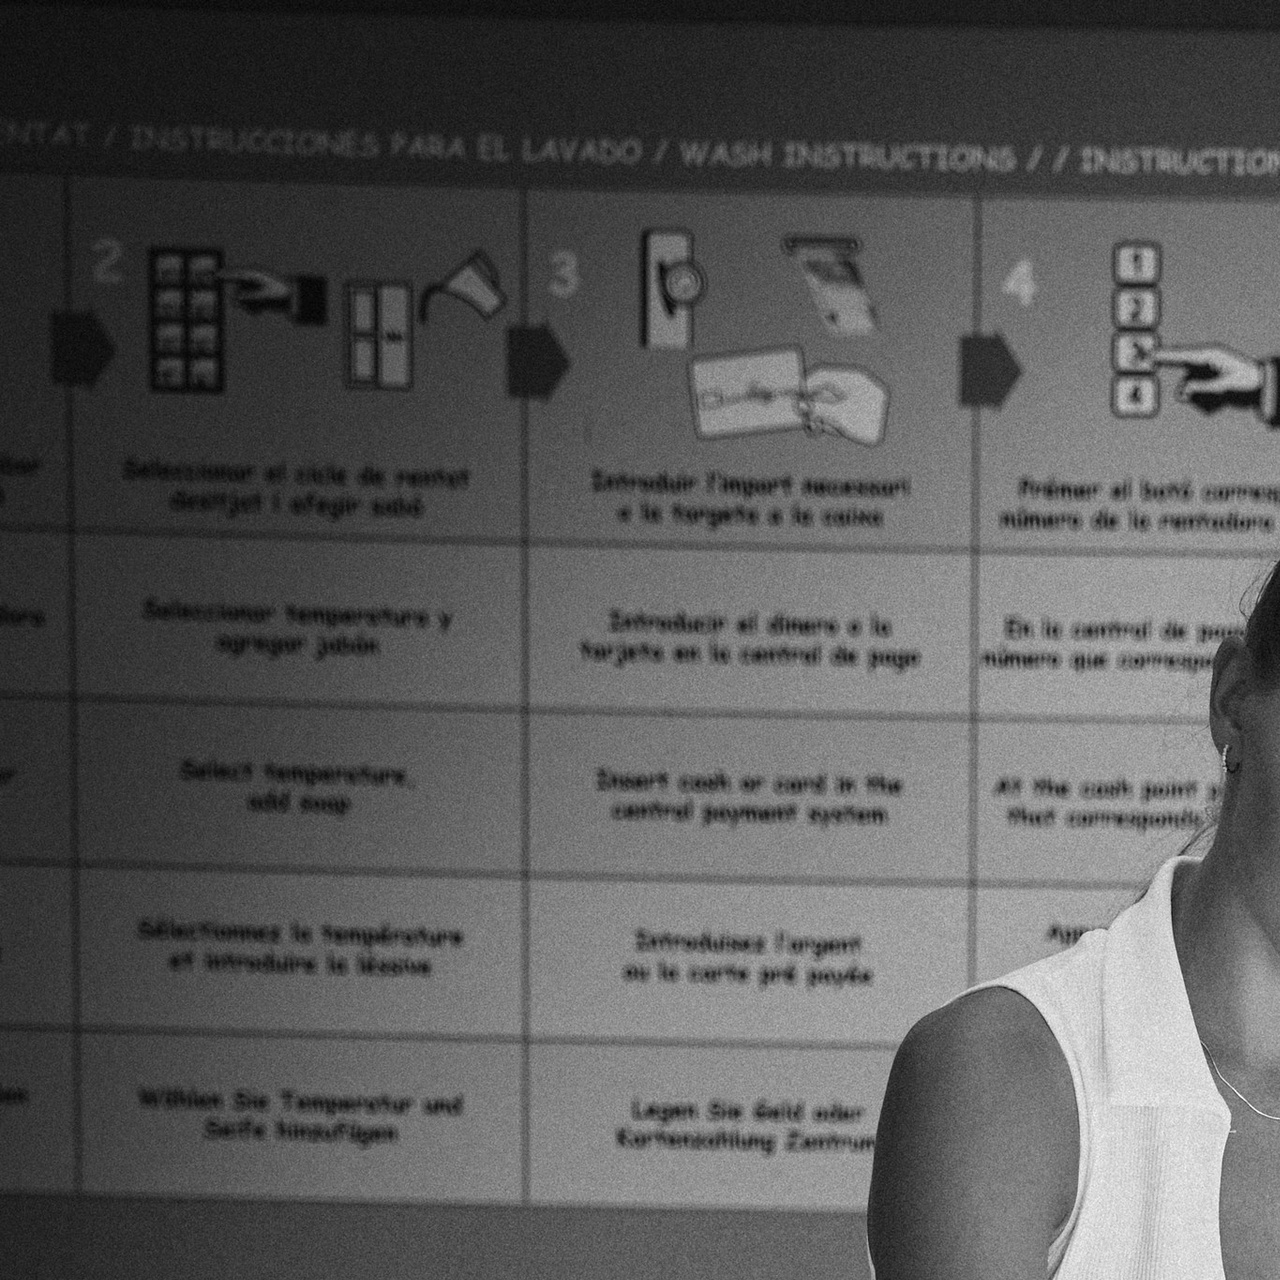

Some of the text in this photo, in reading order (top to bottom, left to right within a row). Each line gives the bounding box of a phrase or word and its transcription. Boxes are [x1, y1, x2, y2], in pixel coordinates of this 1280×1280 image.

[0, 120, 89, 144] NTAT
[132, 128, 379, 152] INSTRUCCIONES
[390, 133, 464, 156] PARA
[476, 133, 509, 161] EL
[522, 138, 642, 162] LAVADO
[680, 142, 772, 165] WASH
[784, 143, 1016, 169] INSTRUCTIONS
[92, 238, 123, 283] 2
[549, 250, 580, 297] 3
[1002, 258, 1037, 306] 4
